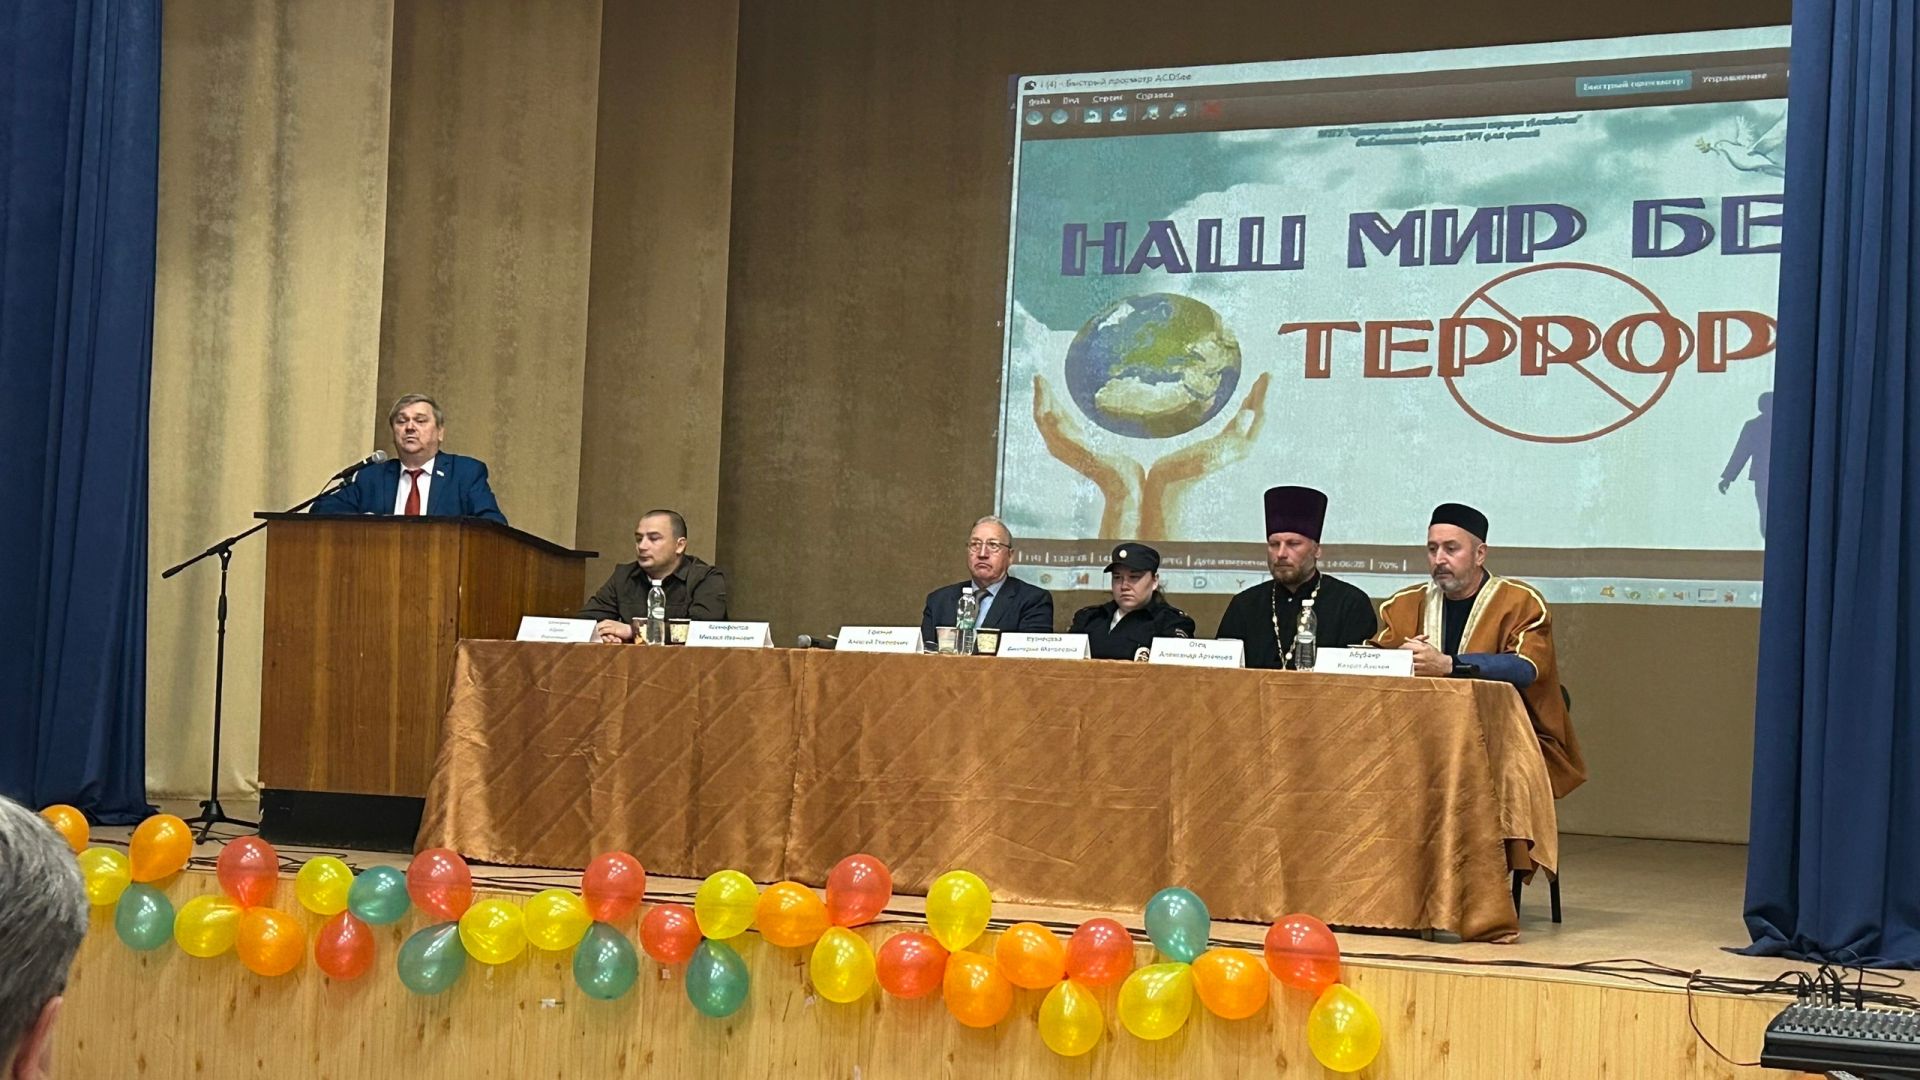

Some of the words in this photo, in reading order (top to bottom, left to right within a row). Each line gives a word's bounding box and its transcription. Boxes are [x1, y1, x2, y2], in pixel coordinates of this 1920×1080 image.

[1066, 78, 1107, 88] Быстрый
[1155, 73, 1192, 83] ACDSee
[1061, 214, 1307, 277] НАШ
[1347, 203, 1587, 269] МИР
[1278, 310, 1778, 379] ТЕРРОР
